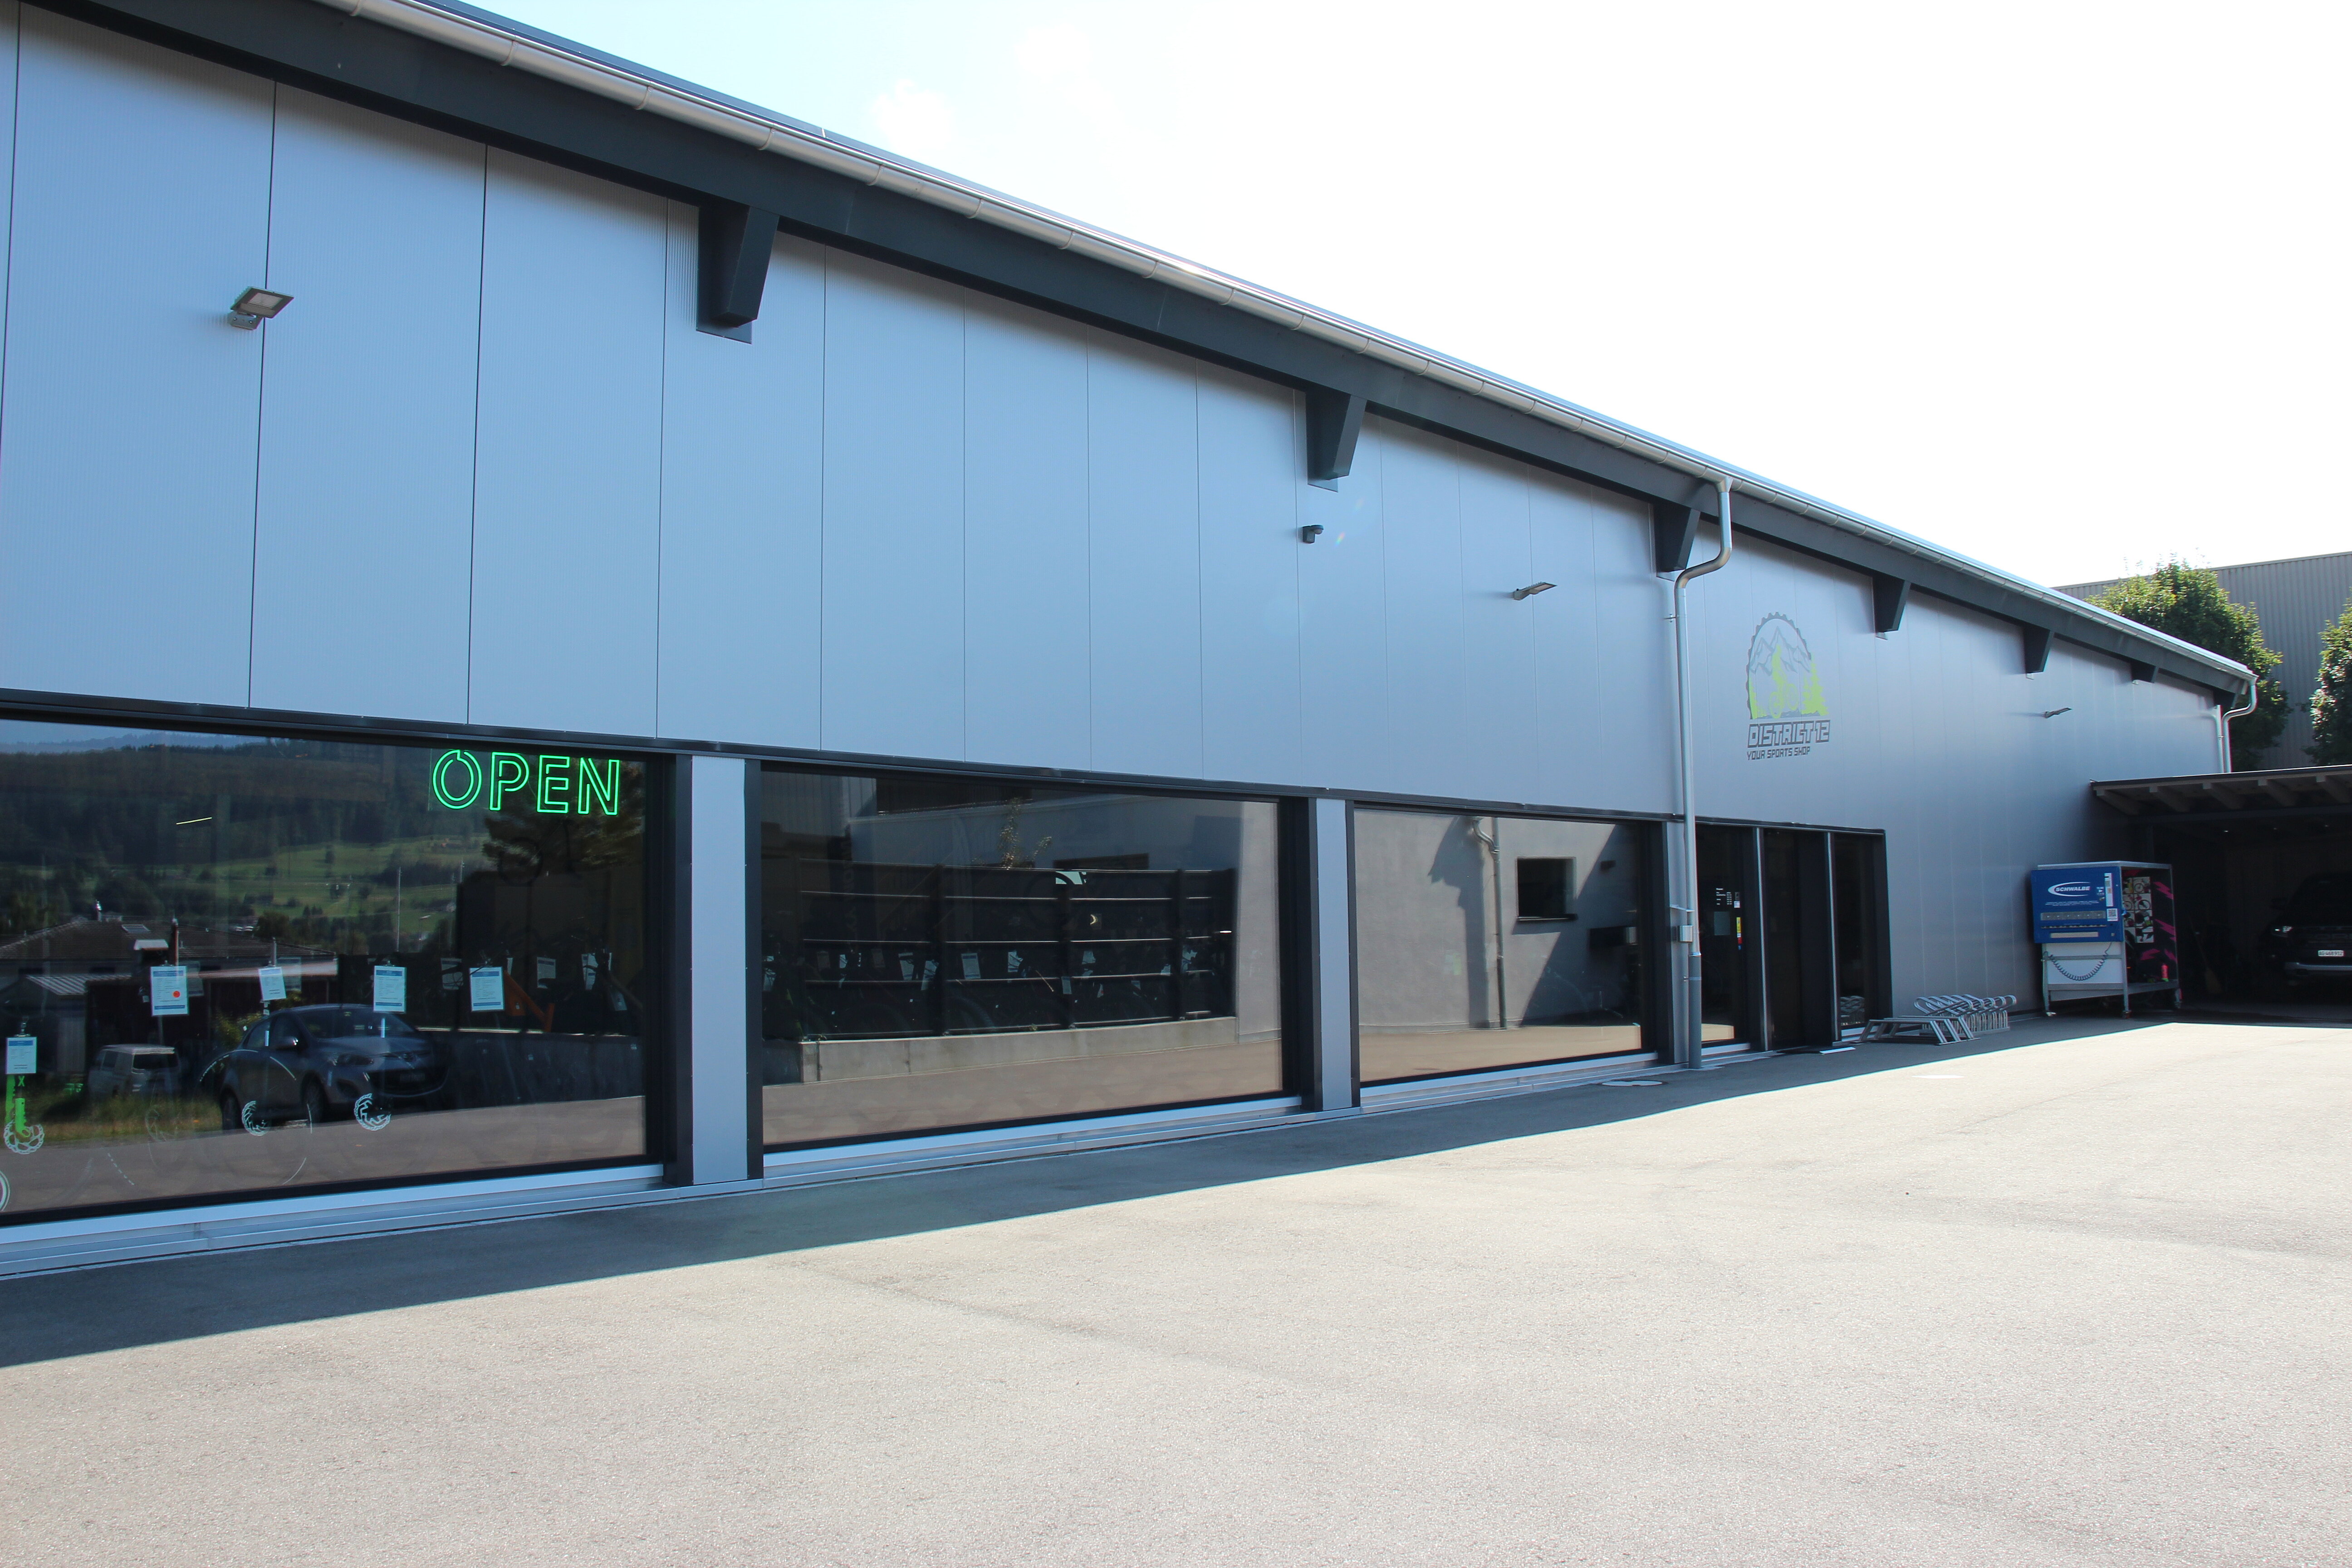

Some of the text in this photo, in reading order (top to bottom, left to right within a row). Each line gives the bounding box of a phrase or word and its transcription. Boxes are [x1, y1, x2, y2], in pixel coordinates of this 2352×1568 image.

[1747, 746, 1810, 760] YOUR SPORTS SHOP
[432, 749, 620, 816] OPEN
